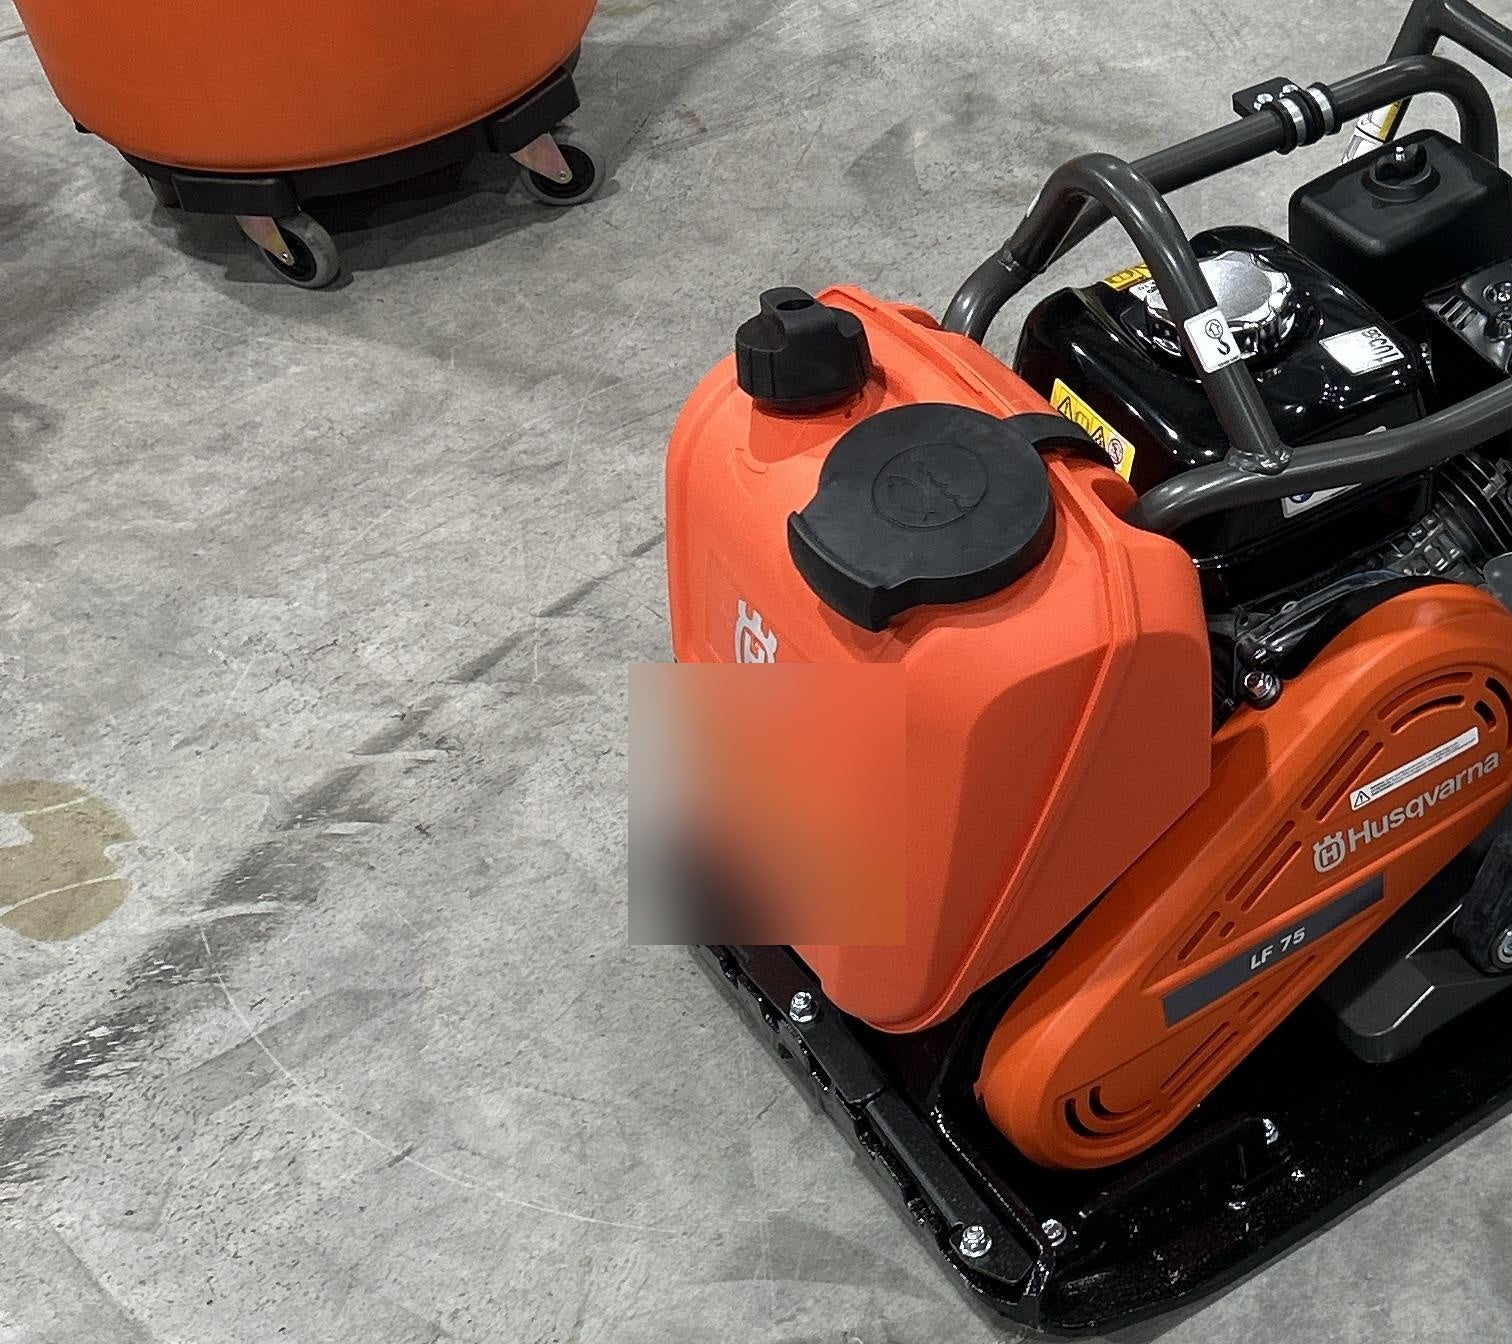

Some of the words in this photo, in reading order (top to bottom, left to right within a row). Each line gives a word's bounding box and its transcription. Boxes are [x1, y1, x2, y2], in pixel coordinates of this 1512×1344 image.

[1349, 751, 1499, 853] Husqvarna
[1250, 944, 1274, 970] LF
[1280, 926, 1306, 953] 75
